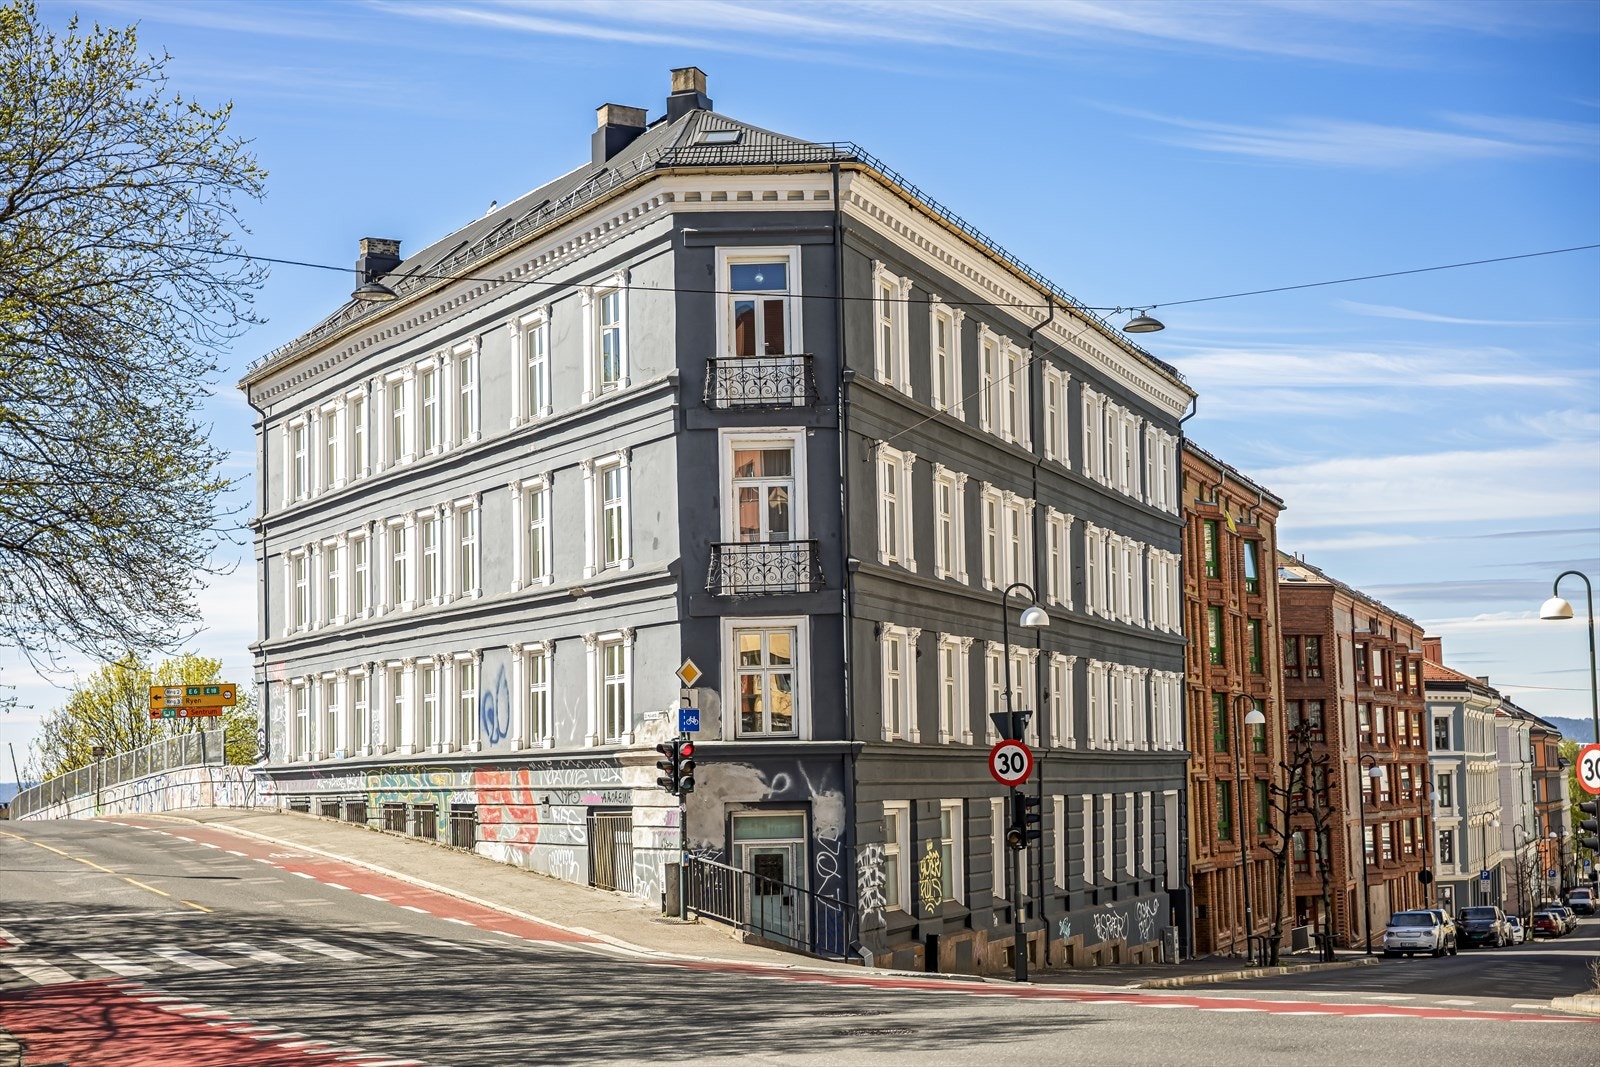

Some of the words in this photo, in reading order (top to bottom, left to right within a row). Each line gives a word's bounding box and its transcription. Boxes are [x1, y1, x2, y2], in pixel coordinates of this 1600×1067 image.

[191, 708, 218, 716] Sentrum
[997, 751, 1025, 775] 30
[1482, 871, 1488, 879] P
